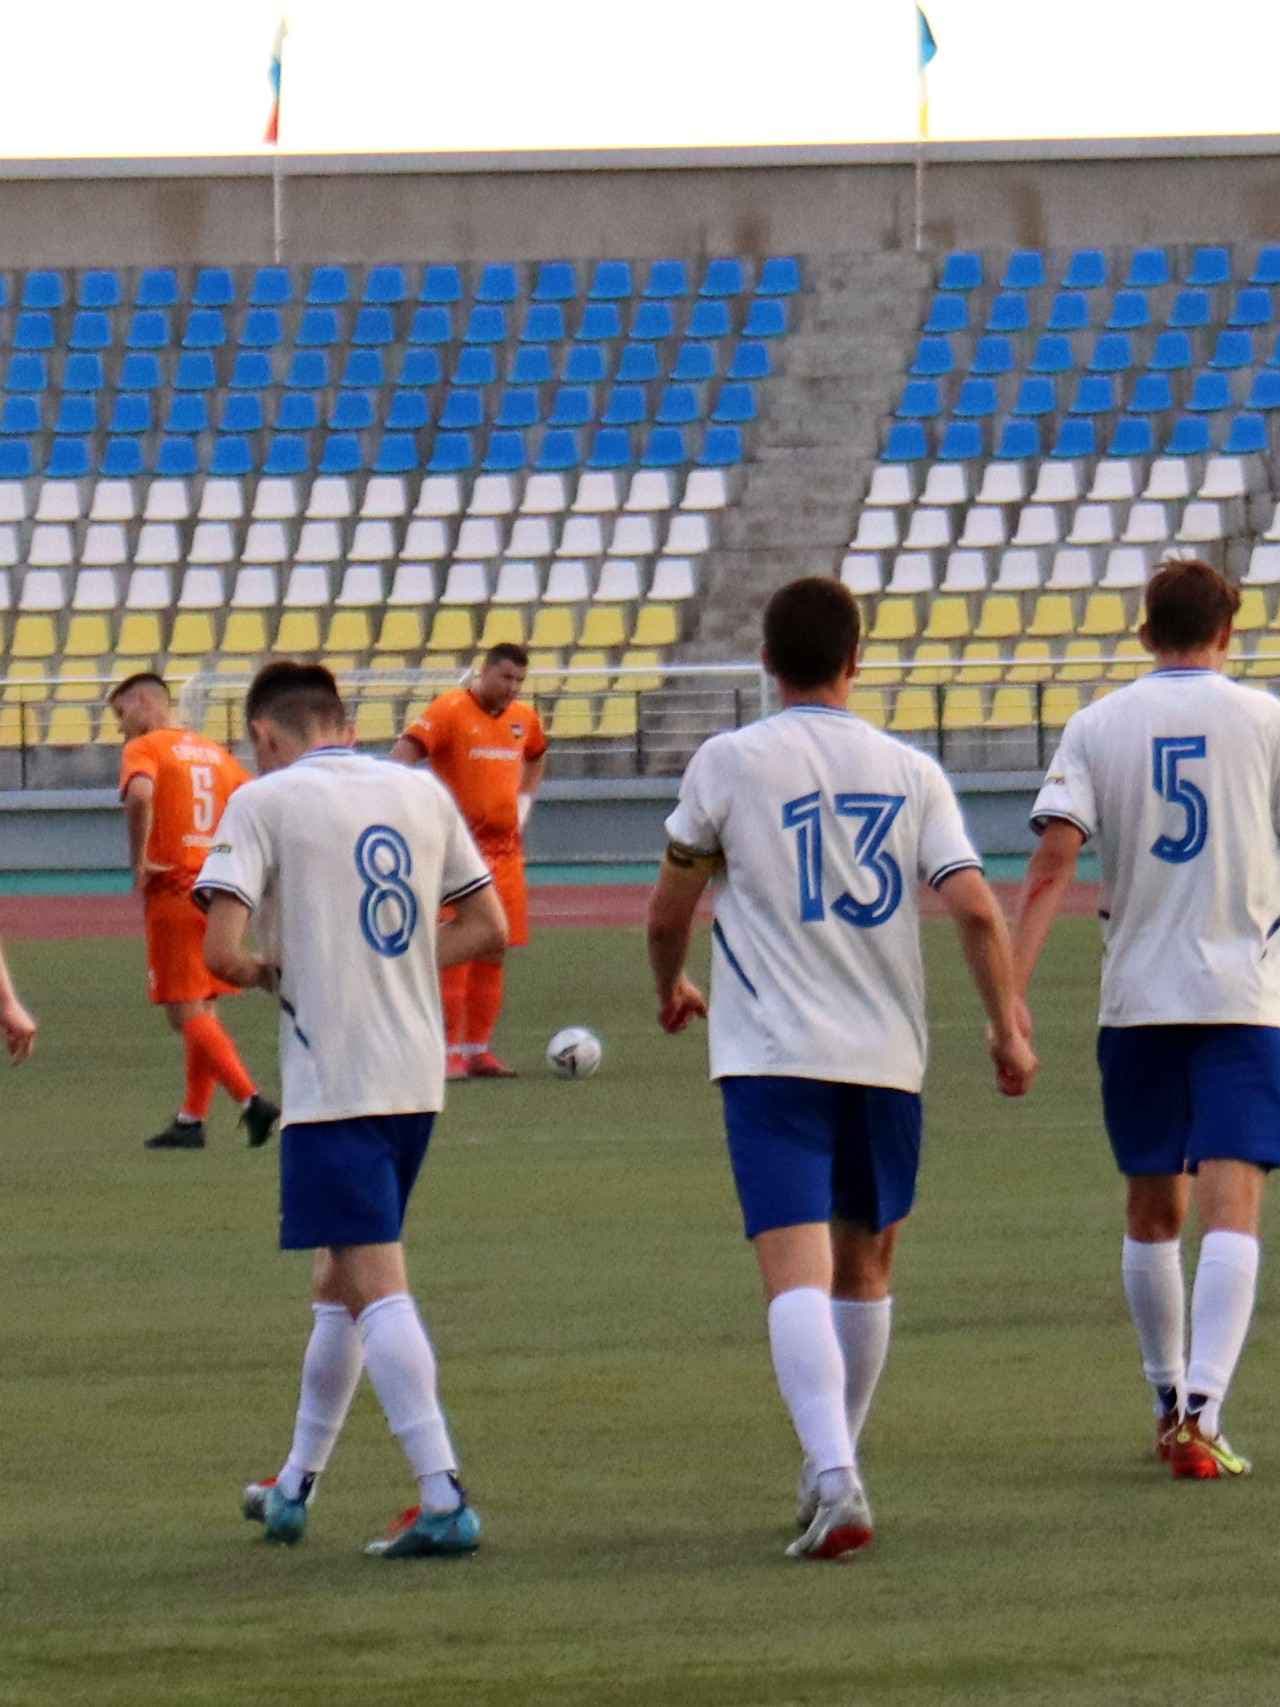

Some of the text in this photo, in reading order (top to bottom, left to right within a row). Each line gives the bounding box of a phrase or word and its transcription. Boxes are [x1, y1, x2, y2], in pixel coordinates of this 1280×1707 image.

[190, 765, 214, 831] 5
[783, 791, 906, 927] 13
[1151, 736, 1207, 863] 5
[355, 825, 417, 957] 8
